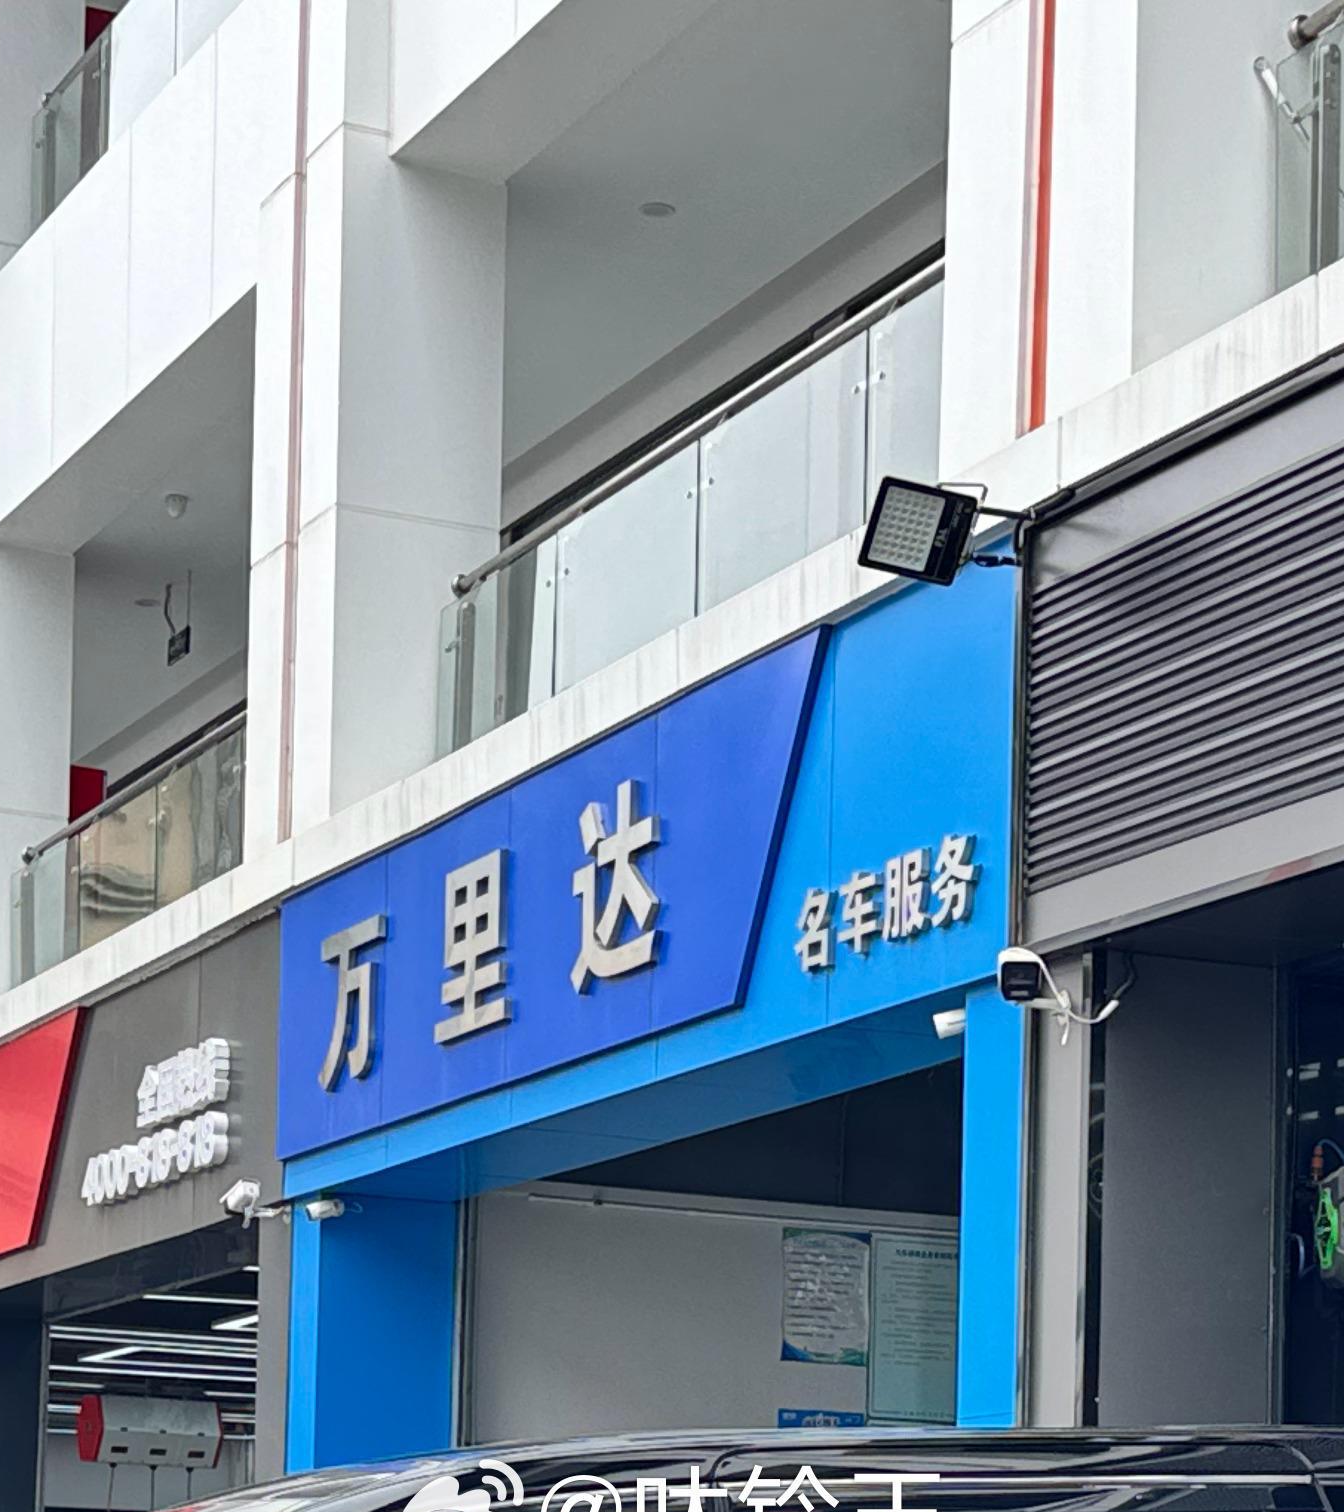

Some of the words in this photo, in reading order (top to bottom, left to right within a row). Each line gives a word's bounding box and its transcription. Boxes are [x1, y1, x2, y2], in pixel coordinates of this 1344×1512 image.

[319, 780, 660, 1092] 万里达
[795, 834, 980, 973] 名车服务
